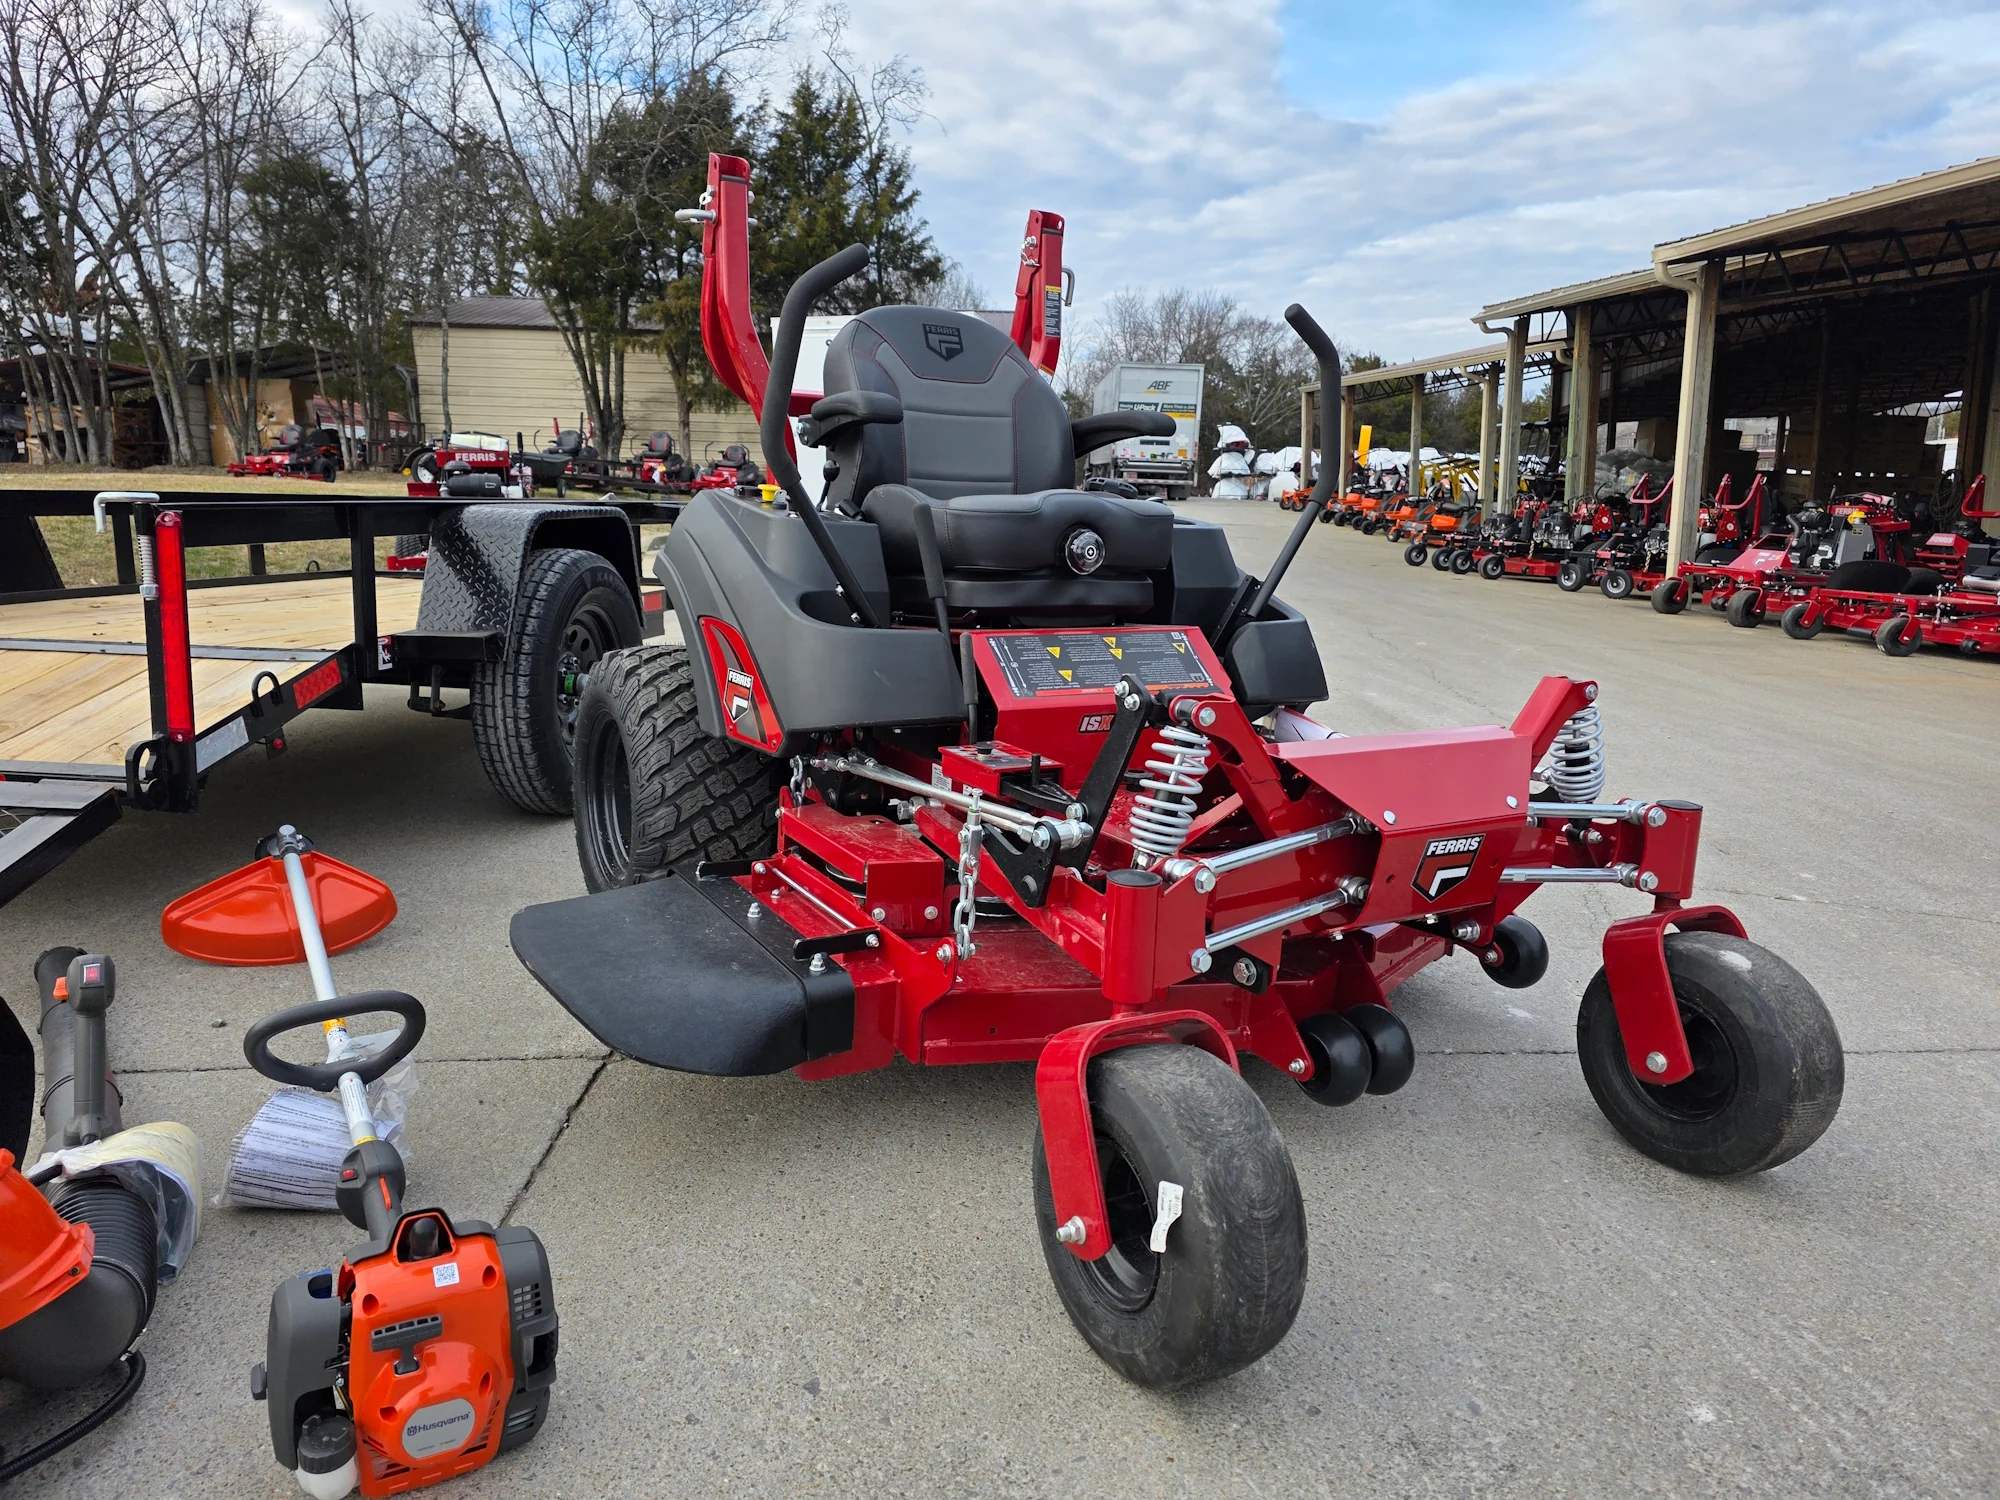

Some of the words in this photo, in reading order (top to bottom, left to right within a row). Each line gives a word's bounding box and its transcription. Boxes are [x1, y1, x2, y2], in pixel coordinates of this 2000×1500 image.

[926, 325, 959, 335] FERRIS
[1147, 381, 1173, 390] ABF
[455, 453, 496, 461] FERRIS
[1929, 535, 1953, 544] FERRIS
[729, 671, 751, 687] FERRIS
[1080, 715, 1114, 731] ISX
[1426, 837, 1480, 855] FERRIS
[418, 1412, 470, 1430] Husqvarna
